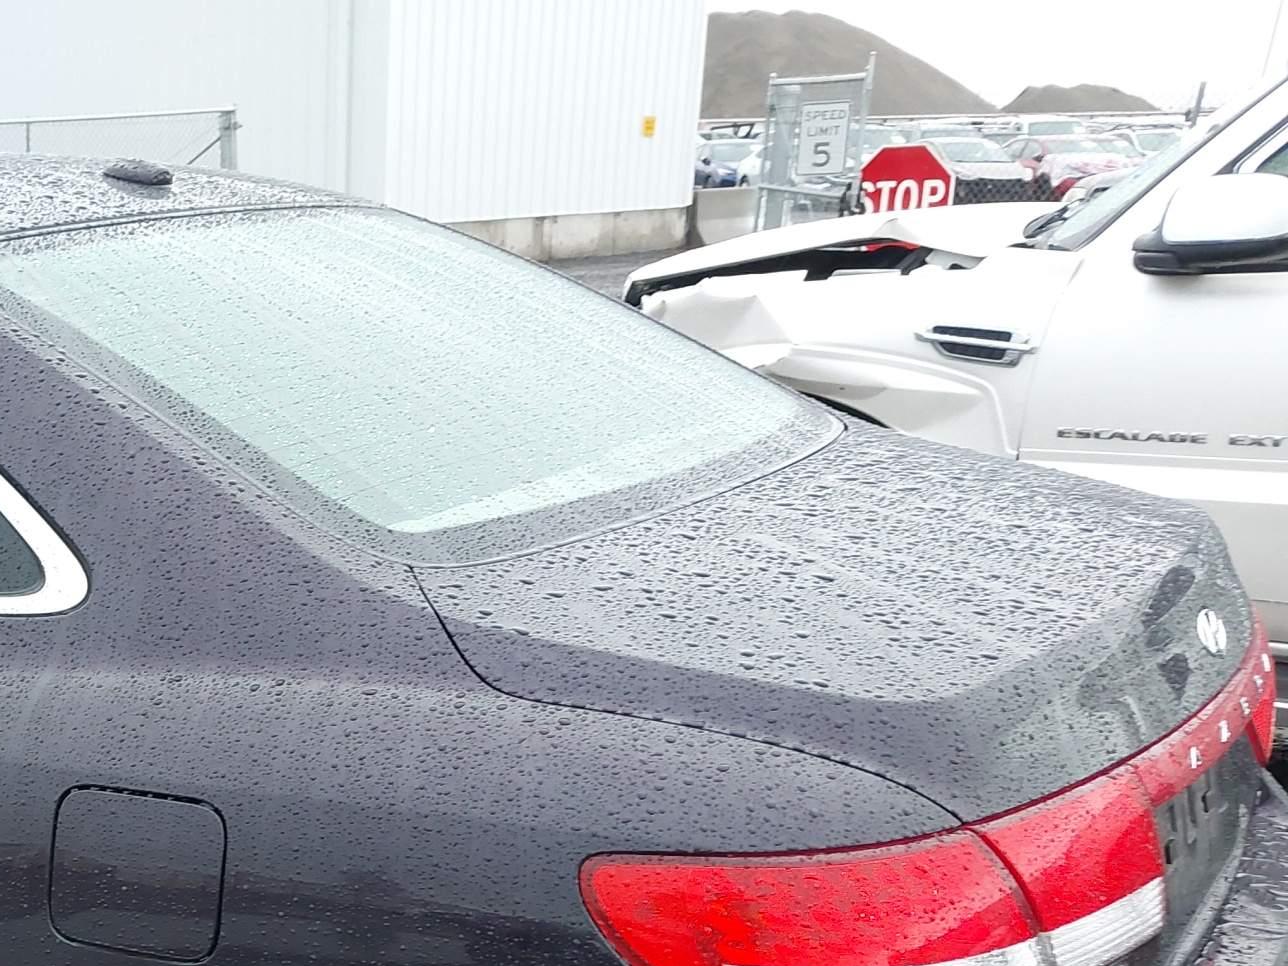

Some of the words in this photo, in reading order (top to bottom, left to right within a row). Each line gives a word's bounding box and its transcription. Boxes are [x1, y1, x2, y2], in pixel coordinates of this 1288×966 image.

[804, 110, 847, 122] SPEED
[807, 125, 841, 137] LIMIT
[812, 142, 831, 167] 5
[861, 178, 947, 214] STOP
[1056, 427, 1209, 445] ESCALADE
[1227, 434, 1288, 448] EXT
